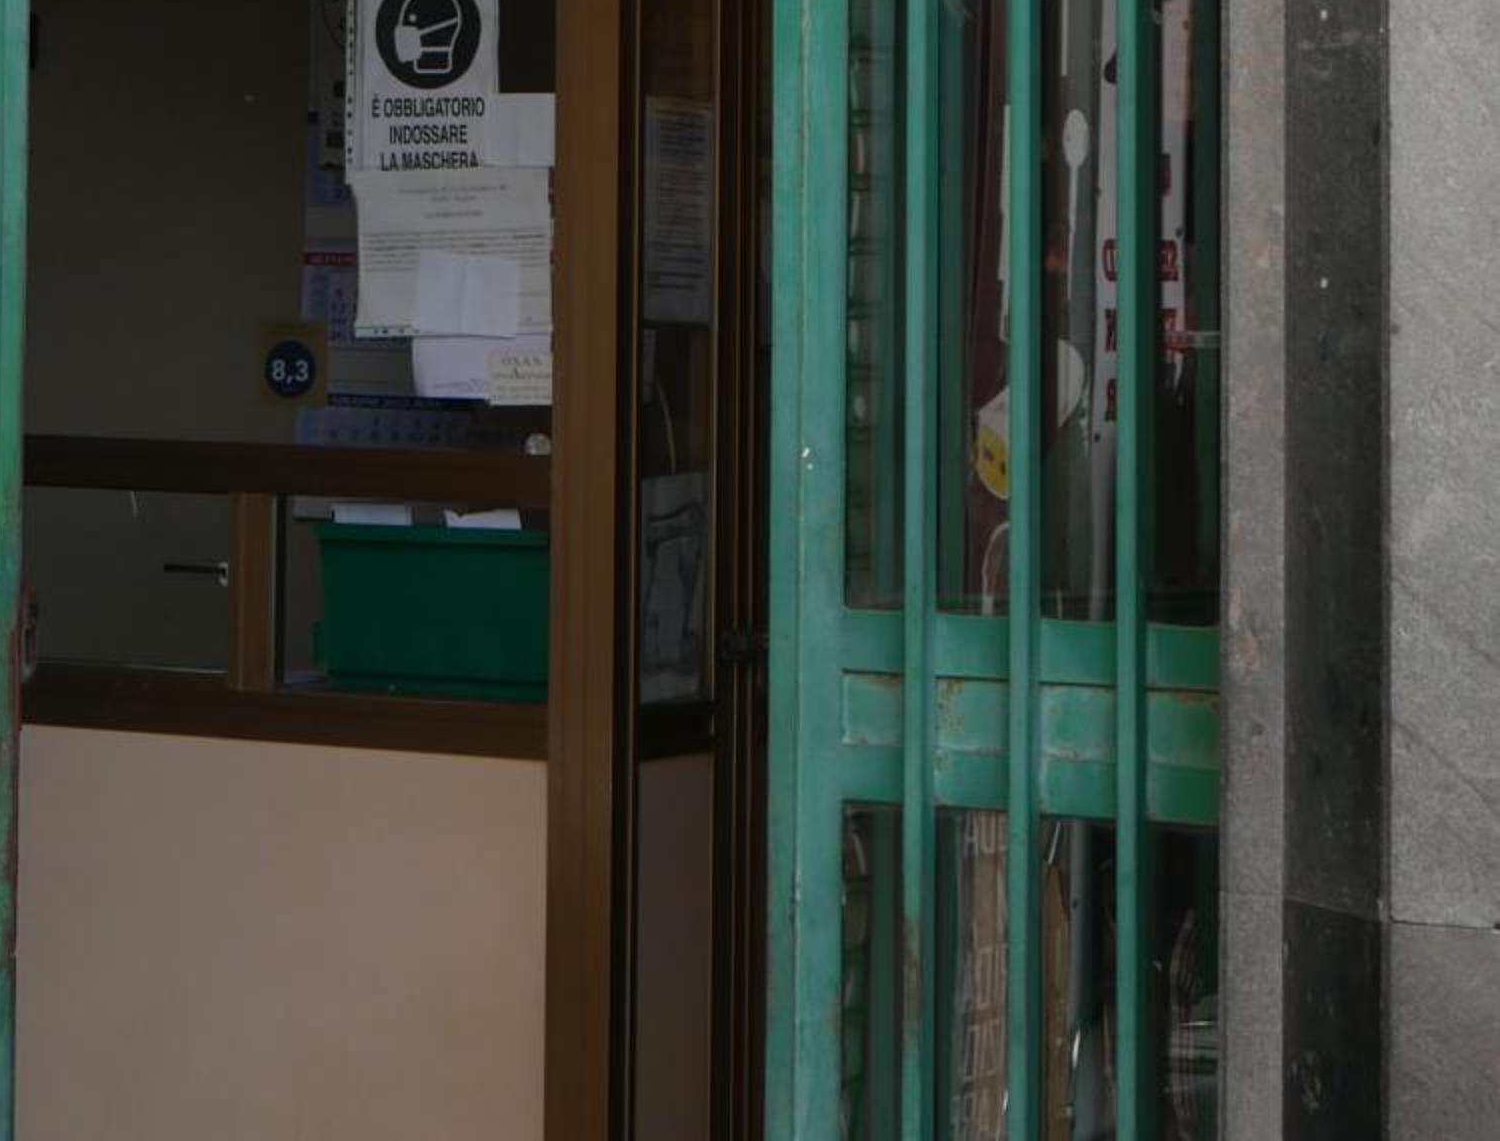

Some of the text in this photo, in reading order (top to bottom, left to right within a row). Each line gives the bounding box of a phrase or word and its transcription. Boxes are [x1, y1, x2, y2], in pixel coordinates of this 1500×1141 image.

[383, 95, 485, 118] OBBLIGATORIO
[389, 124, 468, 145] INDOSSARE
[381, 150, 479, 171] LA MASCHERA
[271, 359, 310, 386] 8,3
